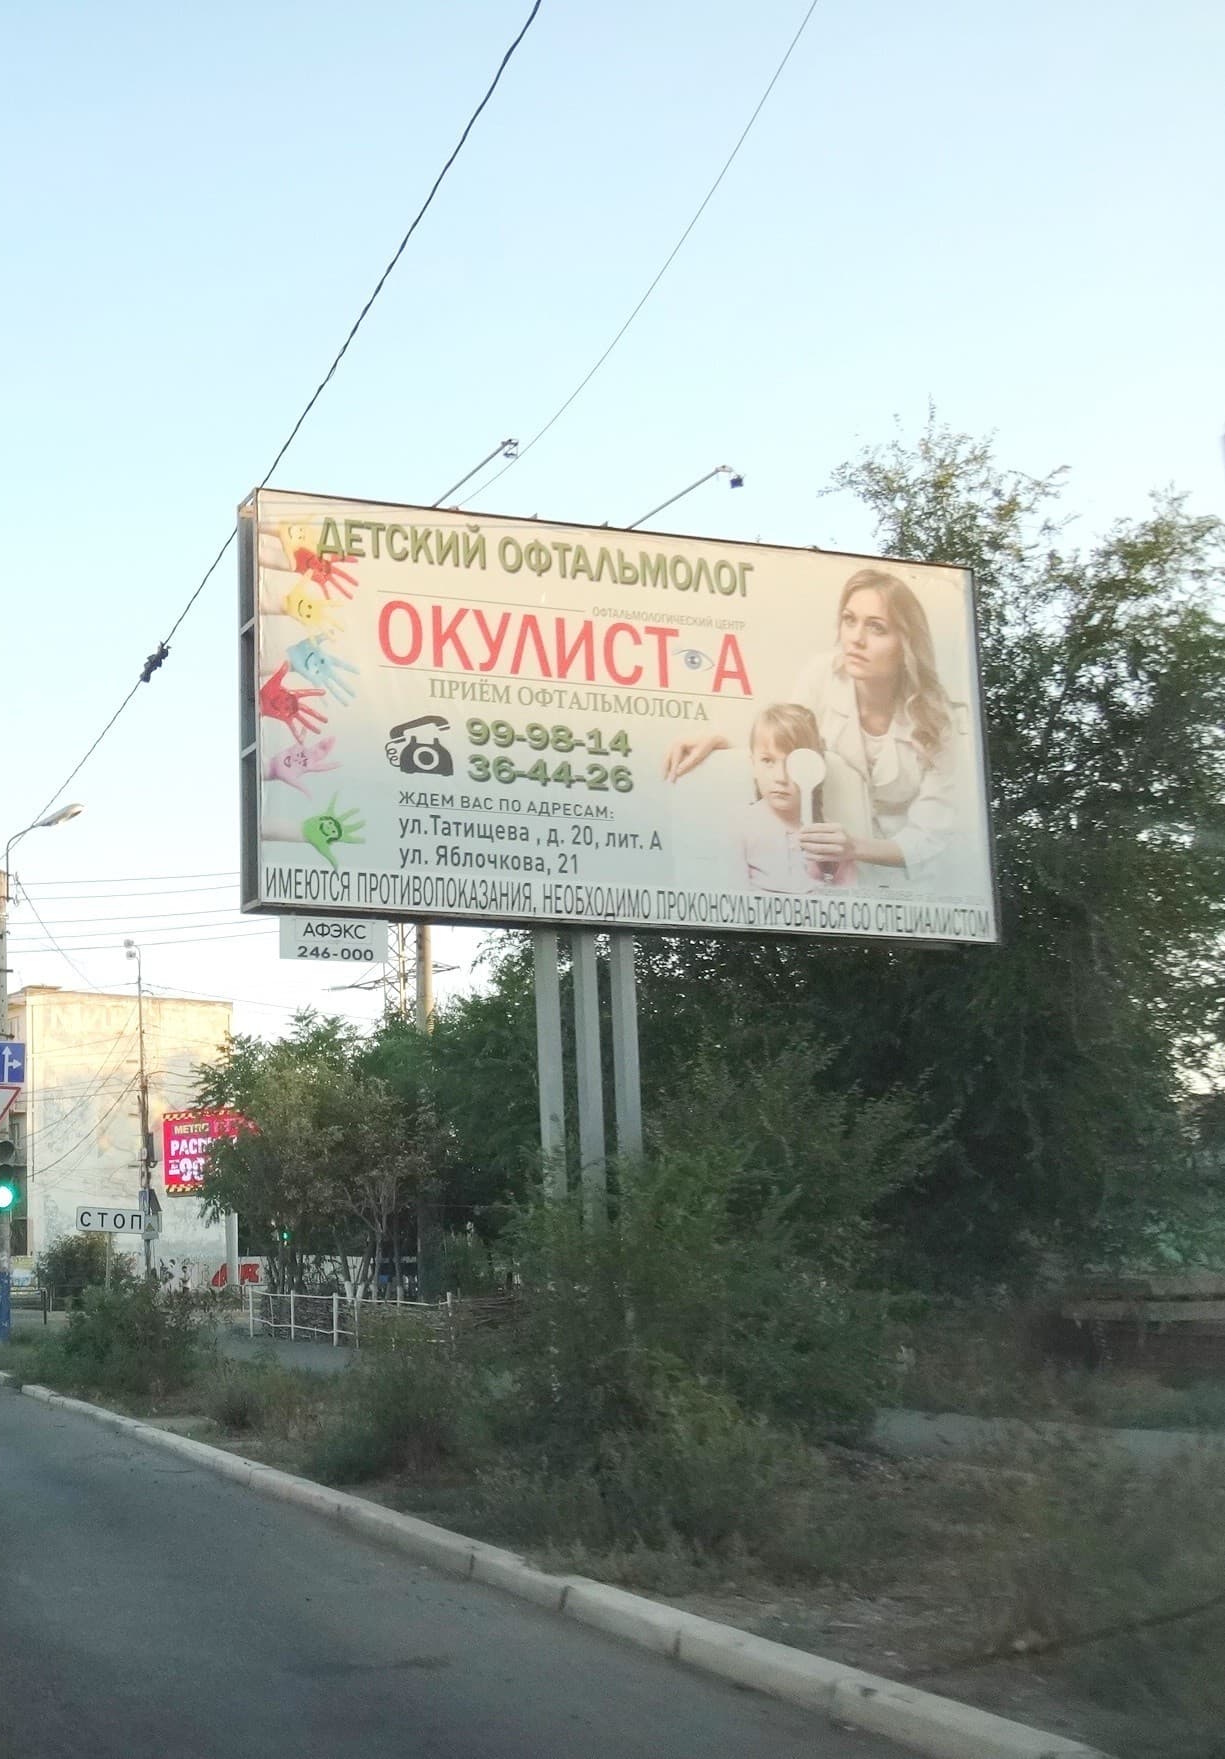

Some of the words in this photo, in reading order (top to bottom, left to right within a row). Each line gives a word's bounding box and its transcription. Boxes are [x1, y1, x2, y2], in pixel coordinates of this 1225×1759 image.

[316, 516, 487, 571] ДЕТСКИЙ
[497, 535, 754, 598] ОФТАЛЬМОЛОГ
[592, 606, 713, 629] ОФТАЛЬМОЛОГИЧЕСКИЙ
[715, 619, 746, 631] ЦЕНТР
[429, 678, 512, 705] ПРИЁМ
[517, 685, 709, 721] ОФТАЛЬМОЛОГА
[466, 717, 632, 758] 99-98-14
[467, 754, 634, 793] 36-44-26
[399, 790, 455, 809] ЖДЕМ
[460, 796, 494, 811] ВАС
[499, 798, 522, 813] ПО
[527, 801, 615, 820] АДРЕСАМ:
[546, 828, 565, 847] д.
[571, 825, 599, 849] 20,
[605, 831, 644, 850] лит.
[650, 830, 663, 850] А
[399, 847, 428, 869] ул.
[435, 845, 552, 875] Яблочкова,
[558, 853, 578, 875] 21
[266, 866, 351, 902] ИМЕЮТСЯ
[357, 872, 537, 916] ПРОТИВОПОКАЗАНИЯ,
[542, 883, 651, 922] НЕОБХОДИМО
[656, 890, 846, 929] ПРОКОНСУЛЬТИРОВАТЬСЯ
[851, 901, 871, 931] СО
[877, 903, 991, 938] СПЕЦИАЛИСТОМ
[302, 922, 367, 940] АФЭКС
[297, 945, 374, 962] 246-000
[80, 1211, 142, 1230] СТОП
